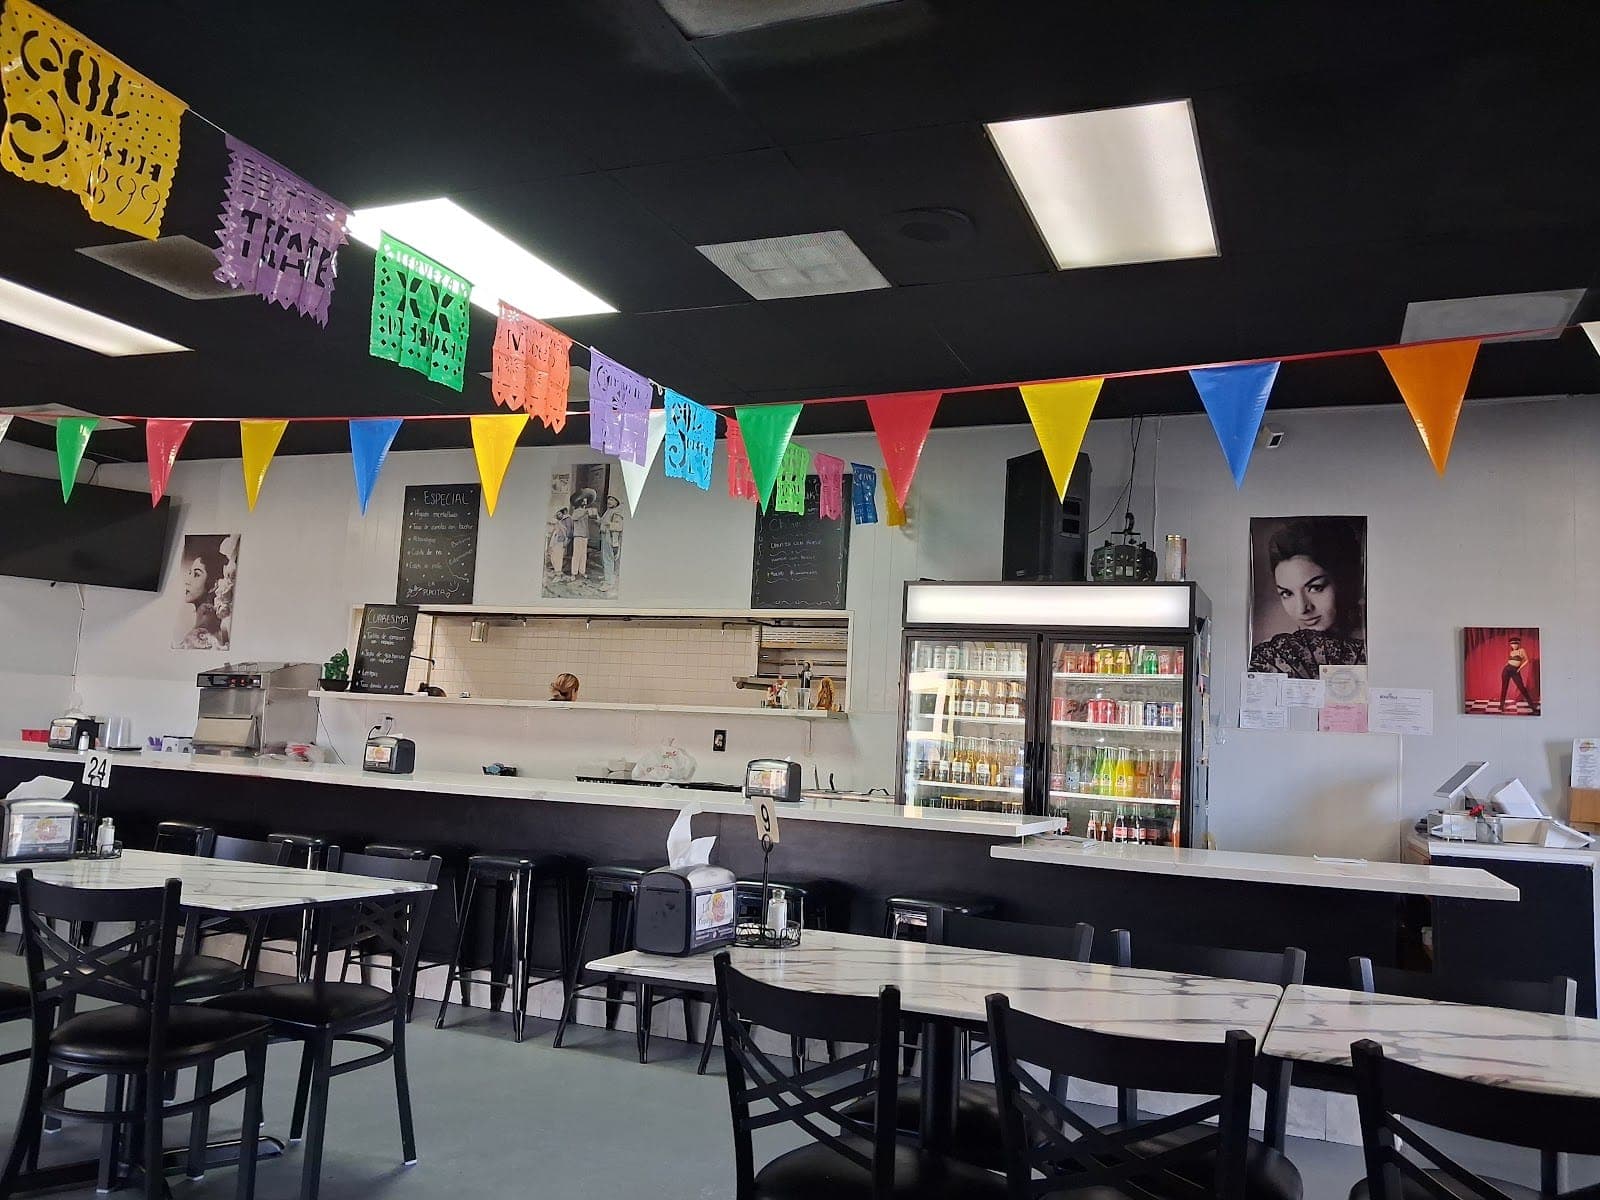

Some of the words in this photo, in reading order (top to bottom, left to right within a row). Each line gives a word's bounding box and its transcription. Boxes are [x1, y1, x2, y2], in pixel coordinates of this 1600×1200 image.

[424, 491, 469, 506] ESPECIAL
[88, 756, 107, 780] 24
[760, 803, 771, 833] 9
